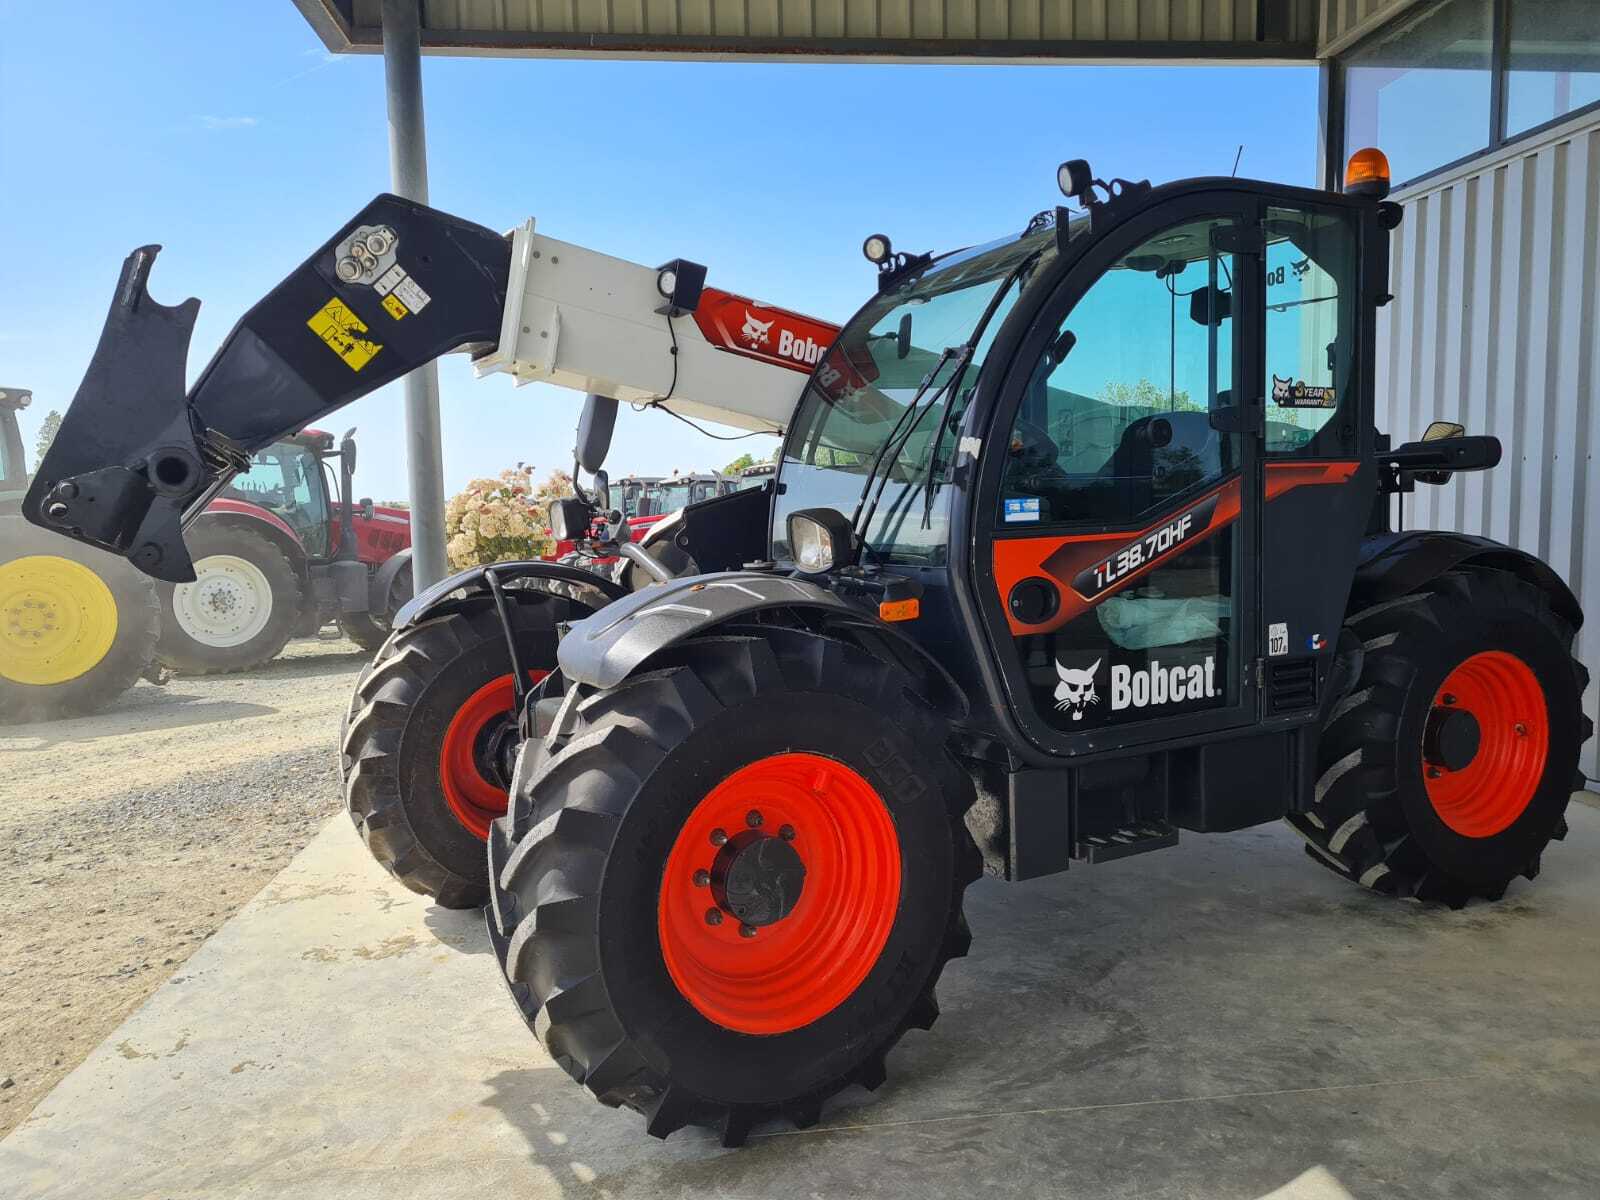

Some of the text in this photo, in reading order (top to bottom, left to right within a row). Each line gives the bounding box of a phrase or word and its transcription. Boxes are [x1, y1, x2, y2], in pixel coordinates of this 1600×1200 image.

[1304, 388, 1324, 397] YEAR
[1094, 514, 1192, 588] TL38.70HF
[1271, 637, 1283, 653] 107
[1111, 656, 1215, 710] Bobcat
